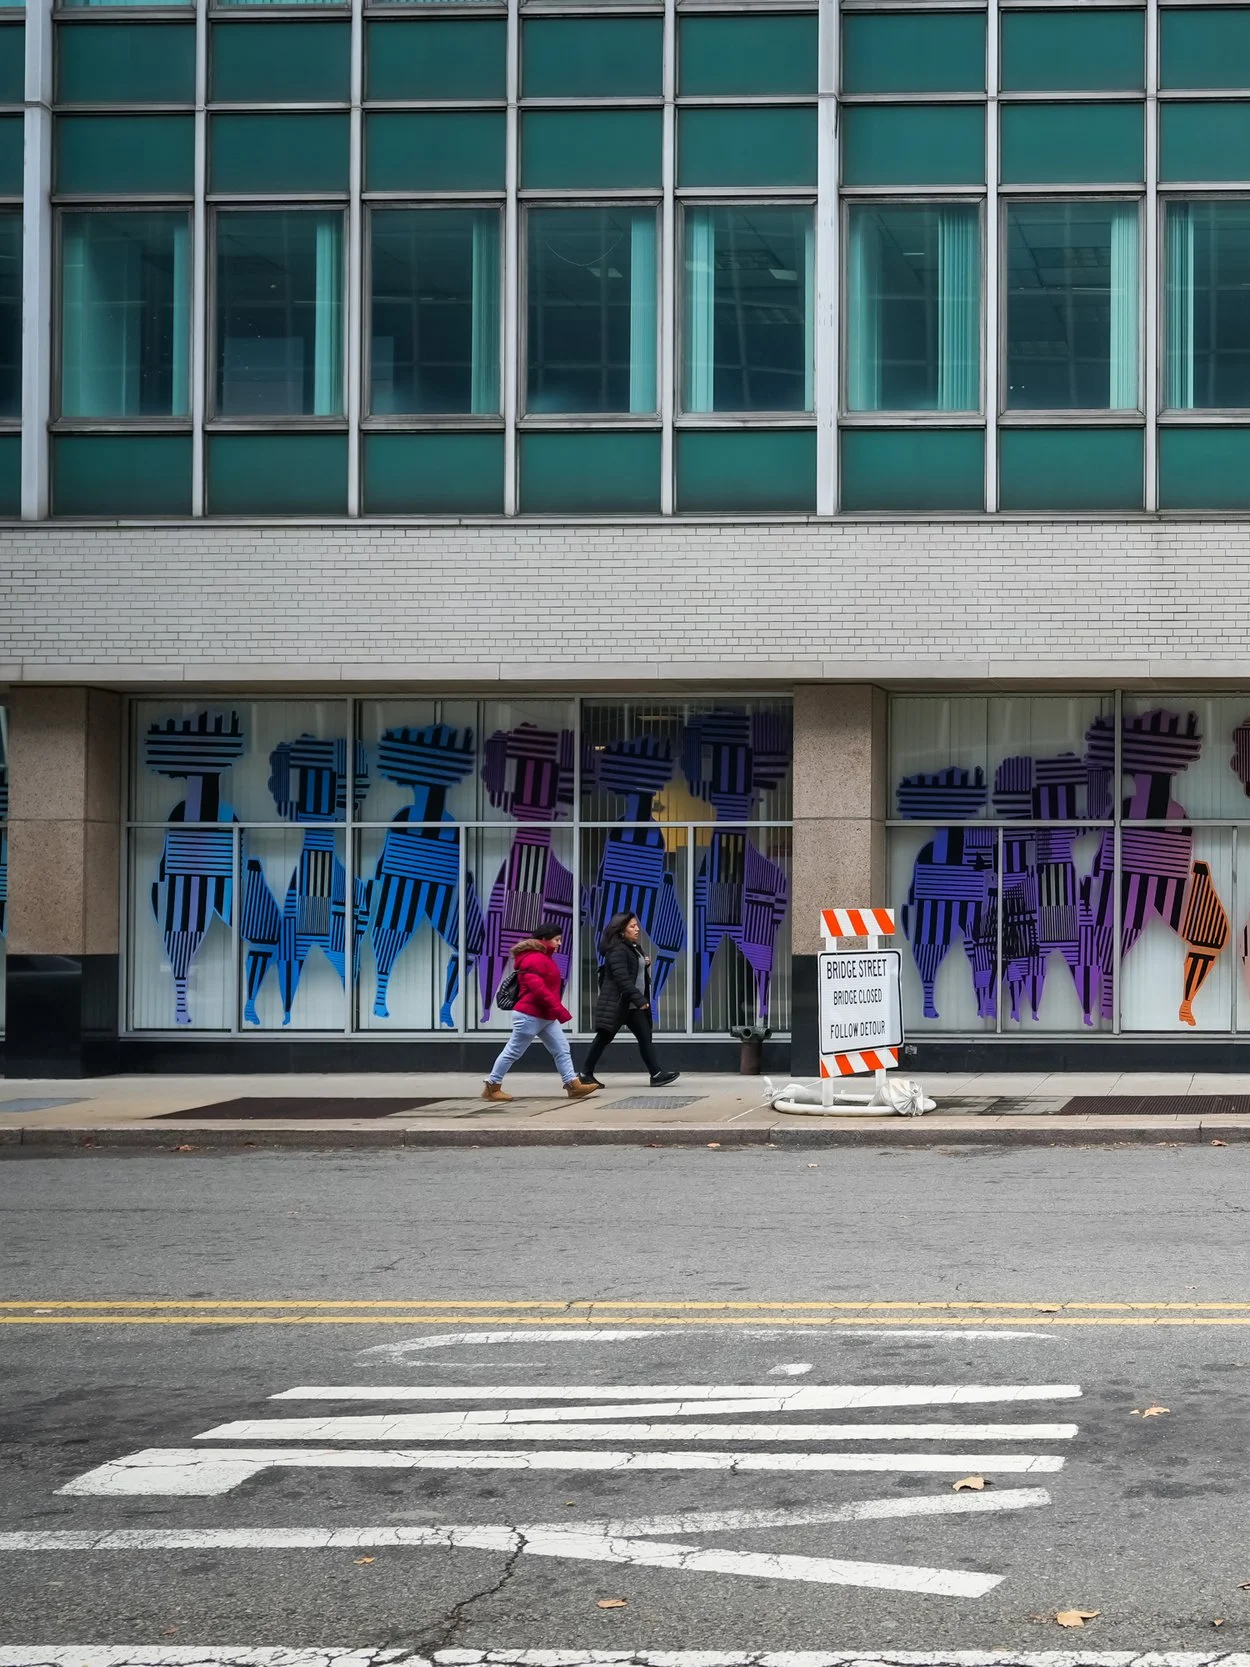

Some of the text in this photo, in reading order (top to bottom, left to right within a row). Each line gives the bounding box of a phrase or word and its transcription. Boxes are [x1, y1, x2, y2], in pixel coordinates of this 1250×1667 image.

[827, 959, 887, 979] BRIDGE STREET
[834, 988, 882, 1005] BRIDGE CLOSED
[831, 1020, 886, 1039] FOLLOW DETOUR
